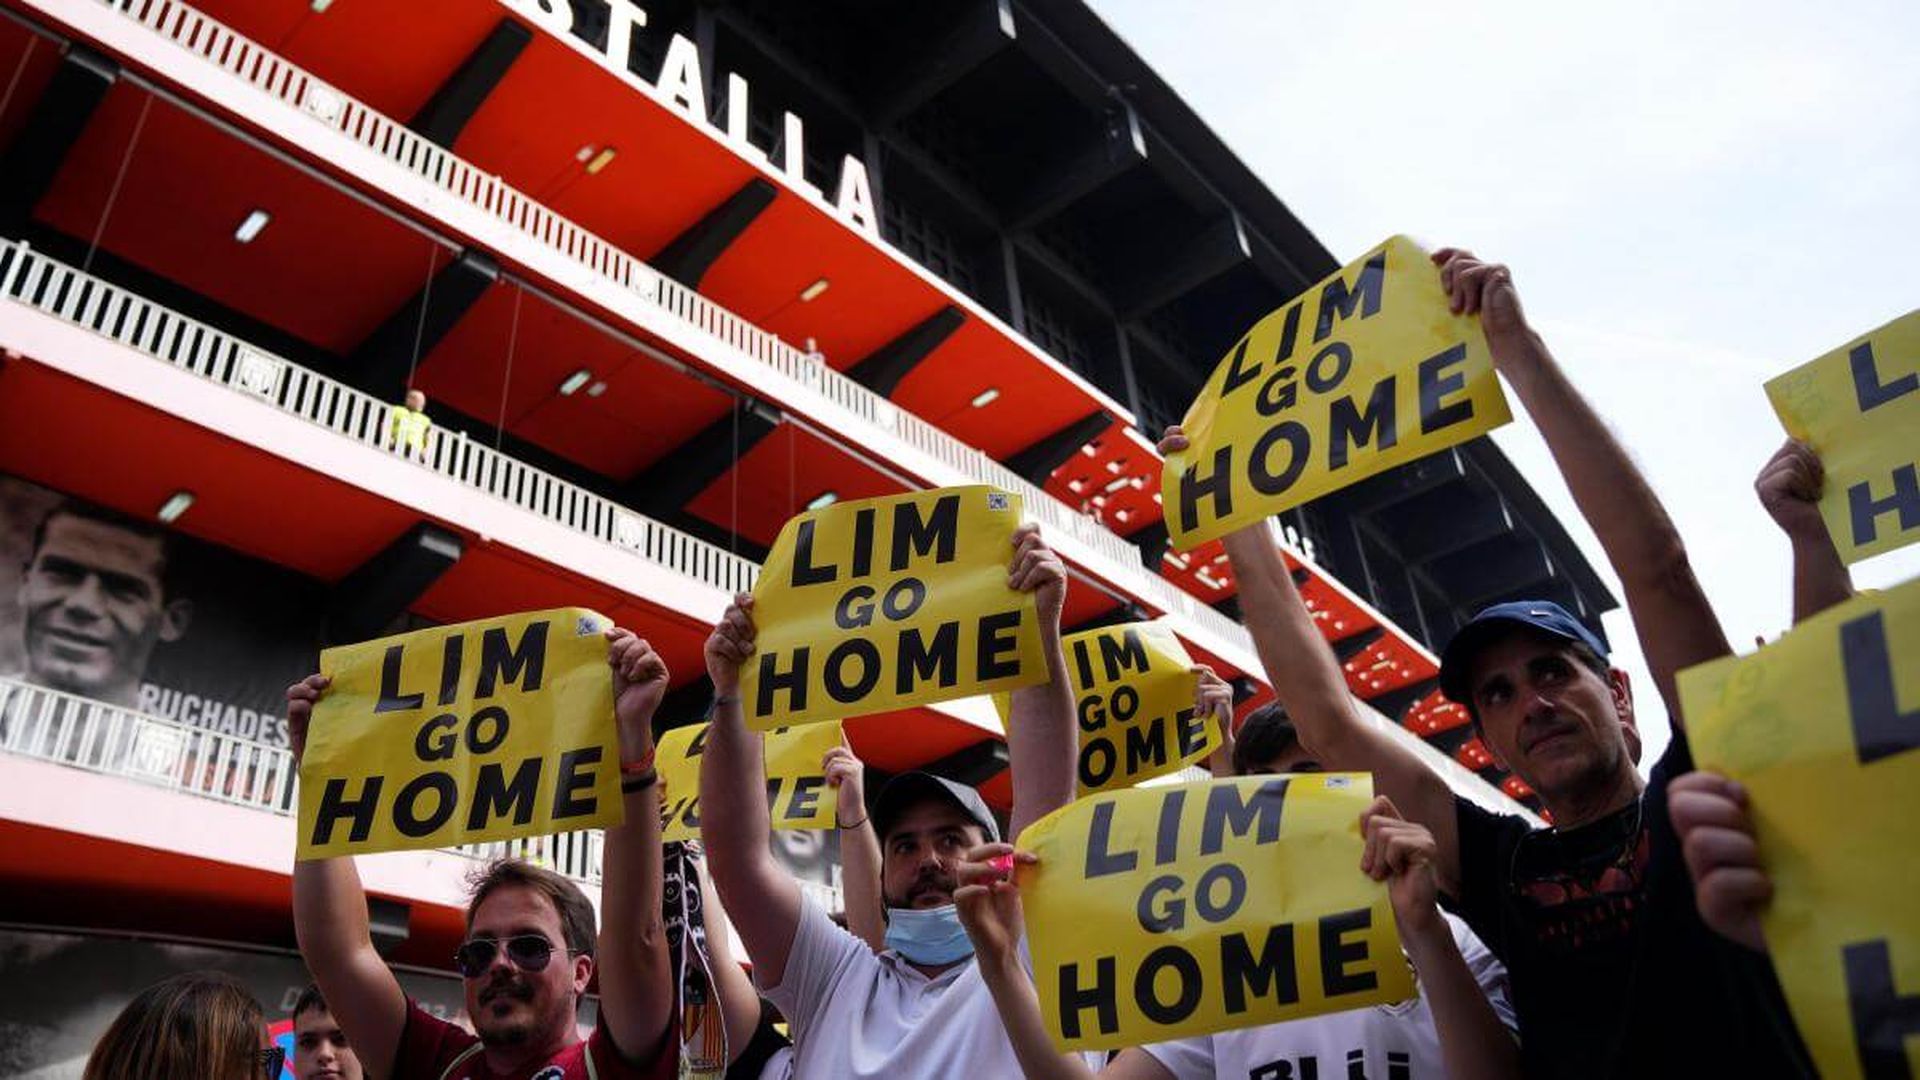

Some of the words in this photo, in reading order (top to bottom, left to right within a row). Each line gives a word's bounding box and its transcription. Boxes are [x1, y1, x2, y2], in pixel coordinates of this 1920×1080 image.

[1220, 250, 1387, 399] LIM
[1255, 341, 1353, 417] GO
[1180, 343, 1474, 534] HOME
[791, 495, 961, 587] LIM
[834, 577, 927, 630] GO
[374, 620, 550, 713] LIM
[756, 610, 1022, 717] HOME
[1073, 629, 1150, 690] IM
[414, 706, 510, 762] GO
[1078, 685, 1140, 733] GO
[1078, 707, 1208, 788] OME
[311, 746, 603, 846] HOME
[1084, 779, 1291, 879] LIM
[1137, 863, 1247, 934] GO
[1058, 908, 1378, 1039] HOME
